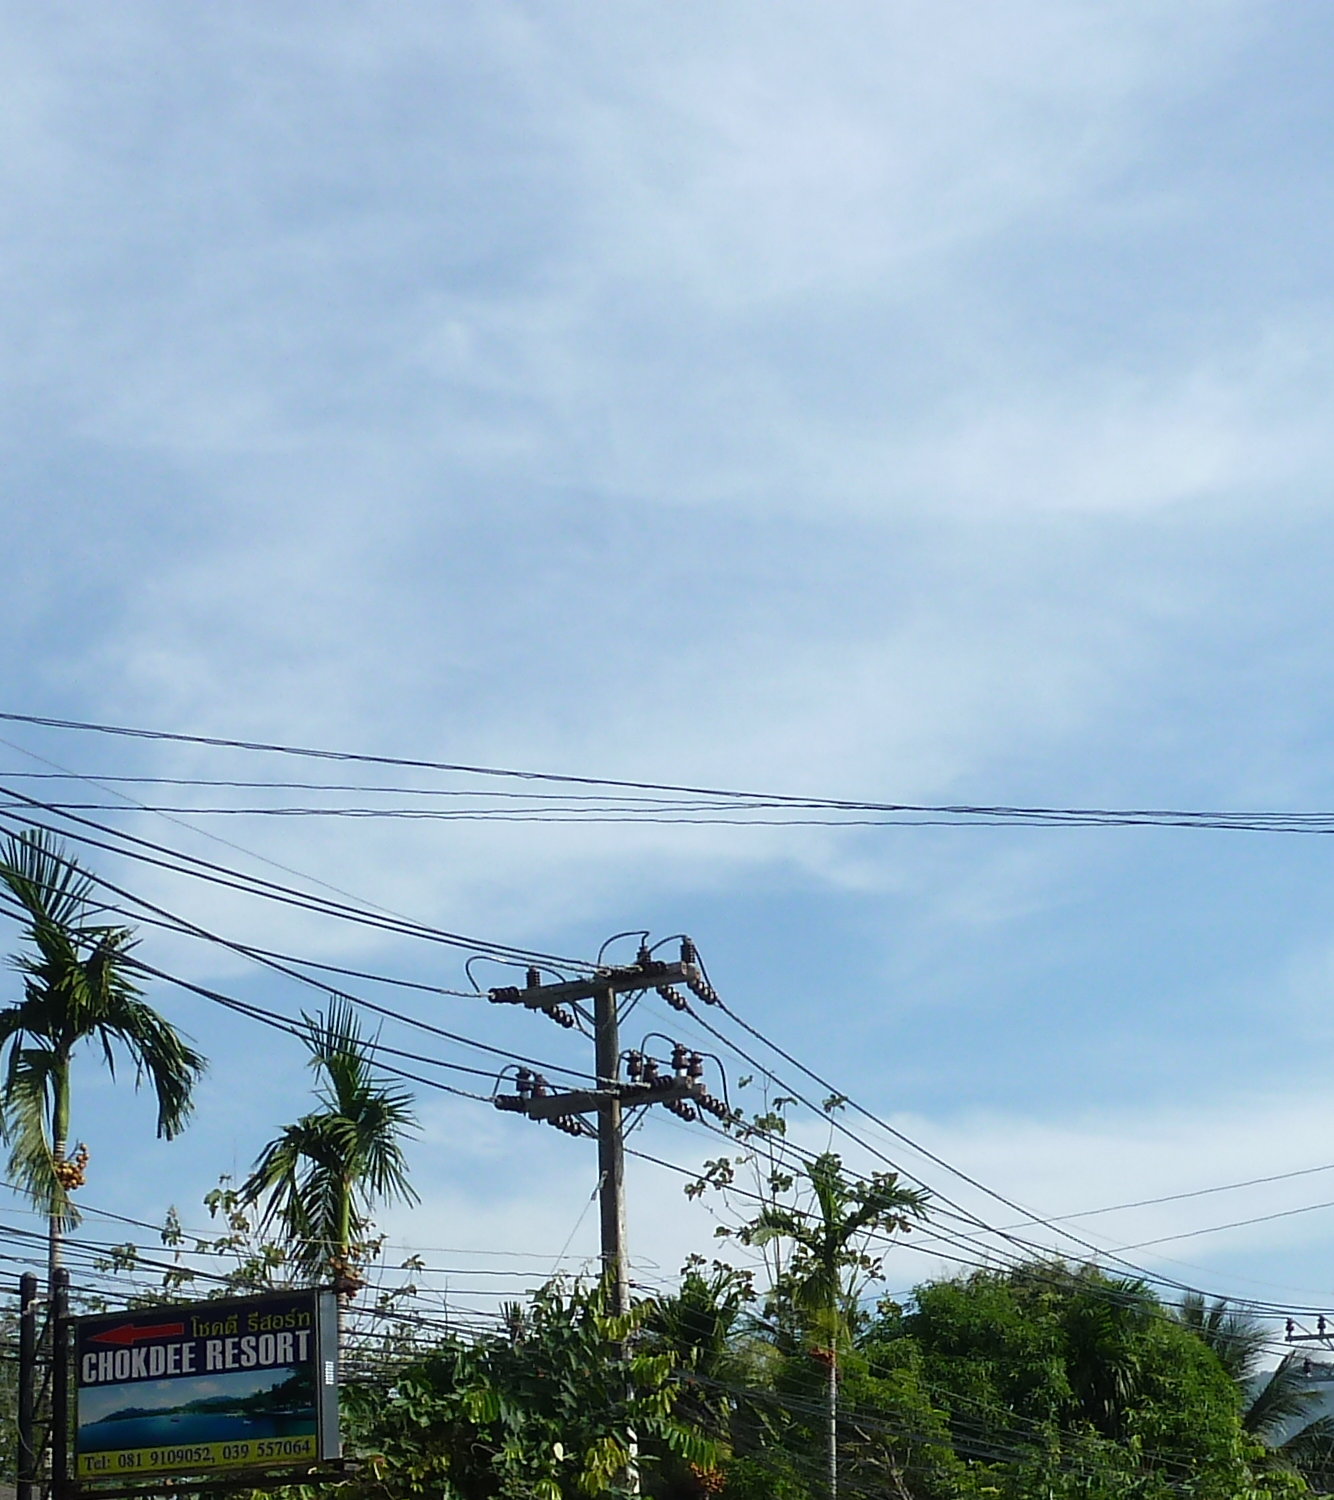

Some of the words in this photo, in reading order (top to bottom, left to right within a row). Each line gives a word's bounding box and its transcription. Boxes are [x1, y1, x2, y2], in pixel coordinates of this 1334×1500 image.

[191, 1314, 239, 1338] โชคดี
[248, 1307, 311, 1332] รีสอร์ท
[82, 1342, 196, 1383] CHOKDEE
[206, 1330, 311, 1371] RESORT
[85, 1457, 111, 1471] Tel:
[118, 1453, 141, 1468] 081
[150, 1447, 215, 1466] 9109052,
[222, 1444, 249, 1460] 039
[257, 1439, 310, 1458] 557064
